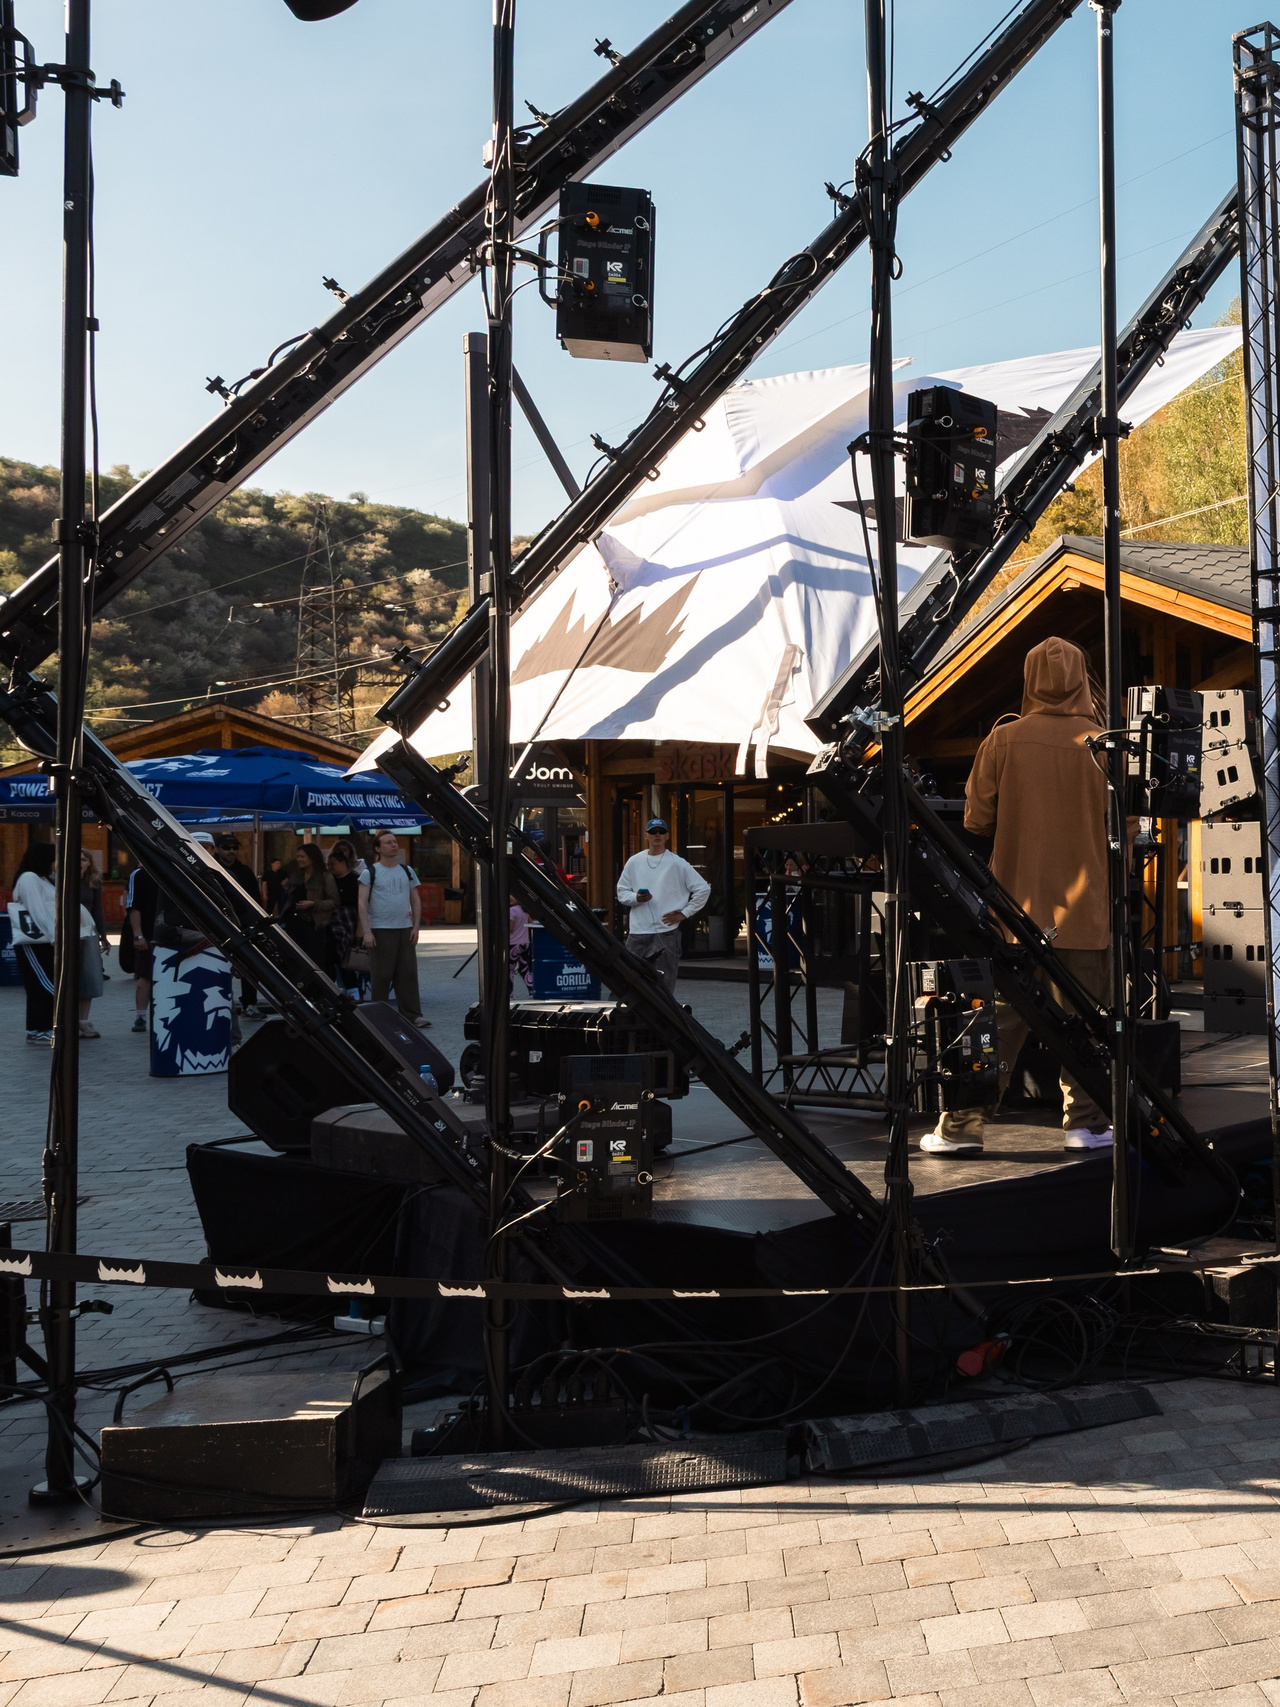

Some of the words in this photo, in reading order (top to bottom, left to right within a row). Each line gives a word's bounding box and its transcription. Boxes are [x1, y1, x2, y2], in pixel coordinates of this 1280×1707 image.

[606, 261, 623, 273] KR
[10, 783, 48, 797] POWE
[307, 792, 342, 806] POWER
[341, 794, 366, 807] YOUR
[556, 974, 591, 987] GORILLA
[610, 1140, 627, 1151] KR
